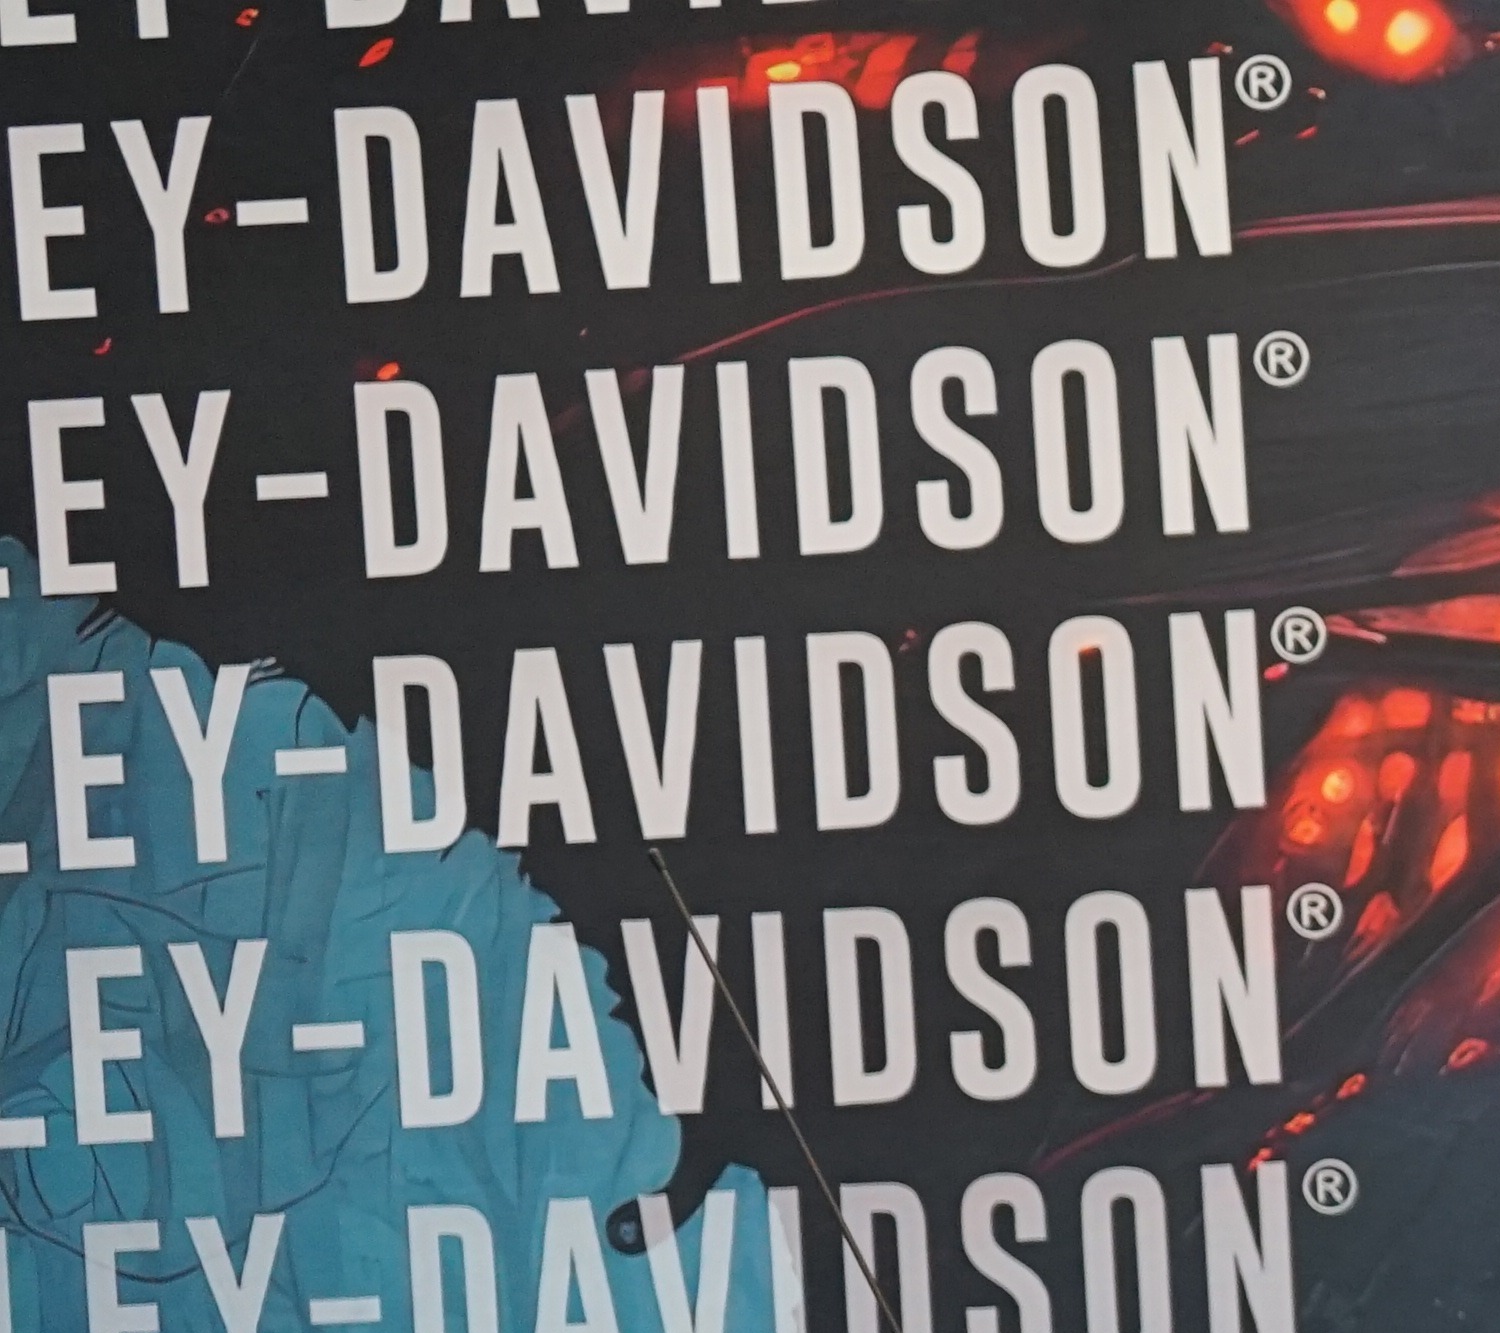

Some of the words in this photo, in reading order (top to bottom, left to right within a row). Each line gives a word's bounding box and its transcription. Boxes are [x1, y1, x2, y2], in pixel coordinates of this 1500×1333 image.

[0, 330, 1310, 597] EY-DAVIDSON®
[0, 606, 1328, 875] EY-DAVIDSON®
[0, 882, 1343, 1150] EY-DAVIDSON®
